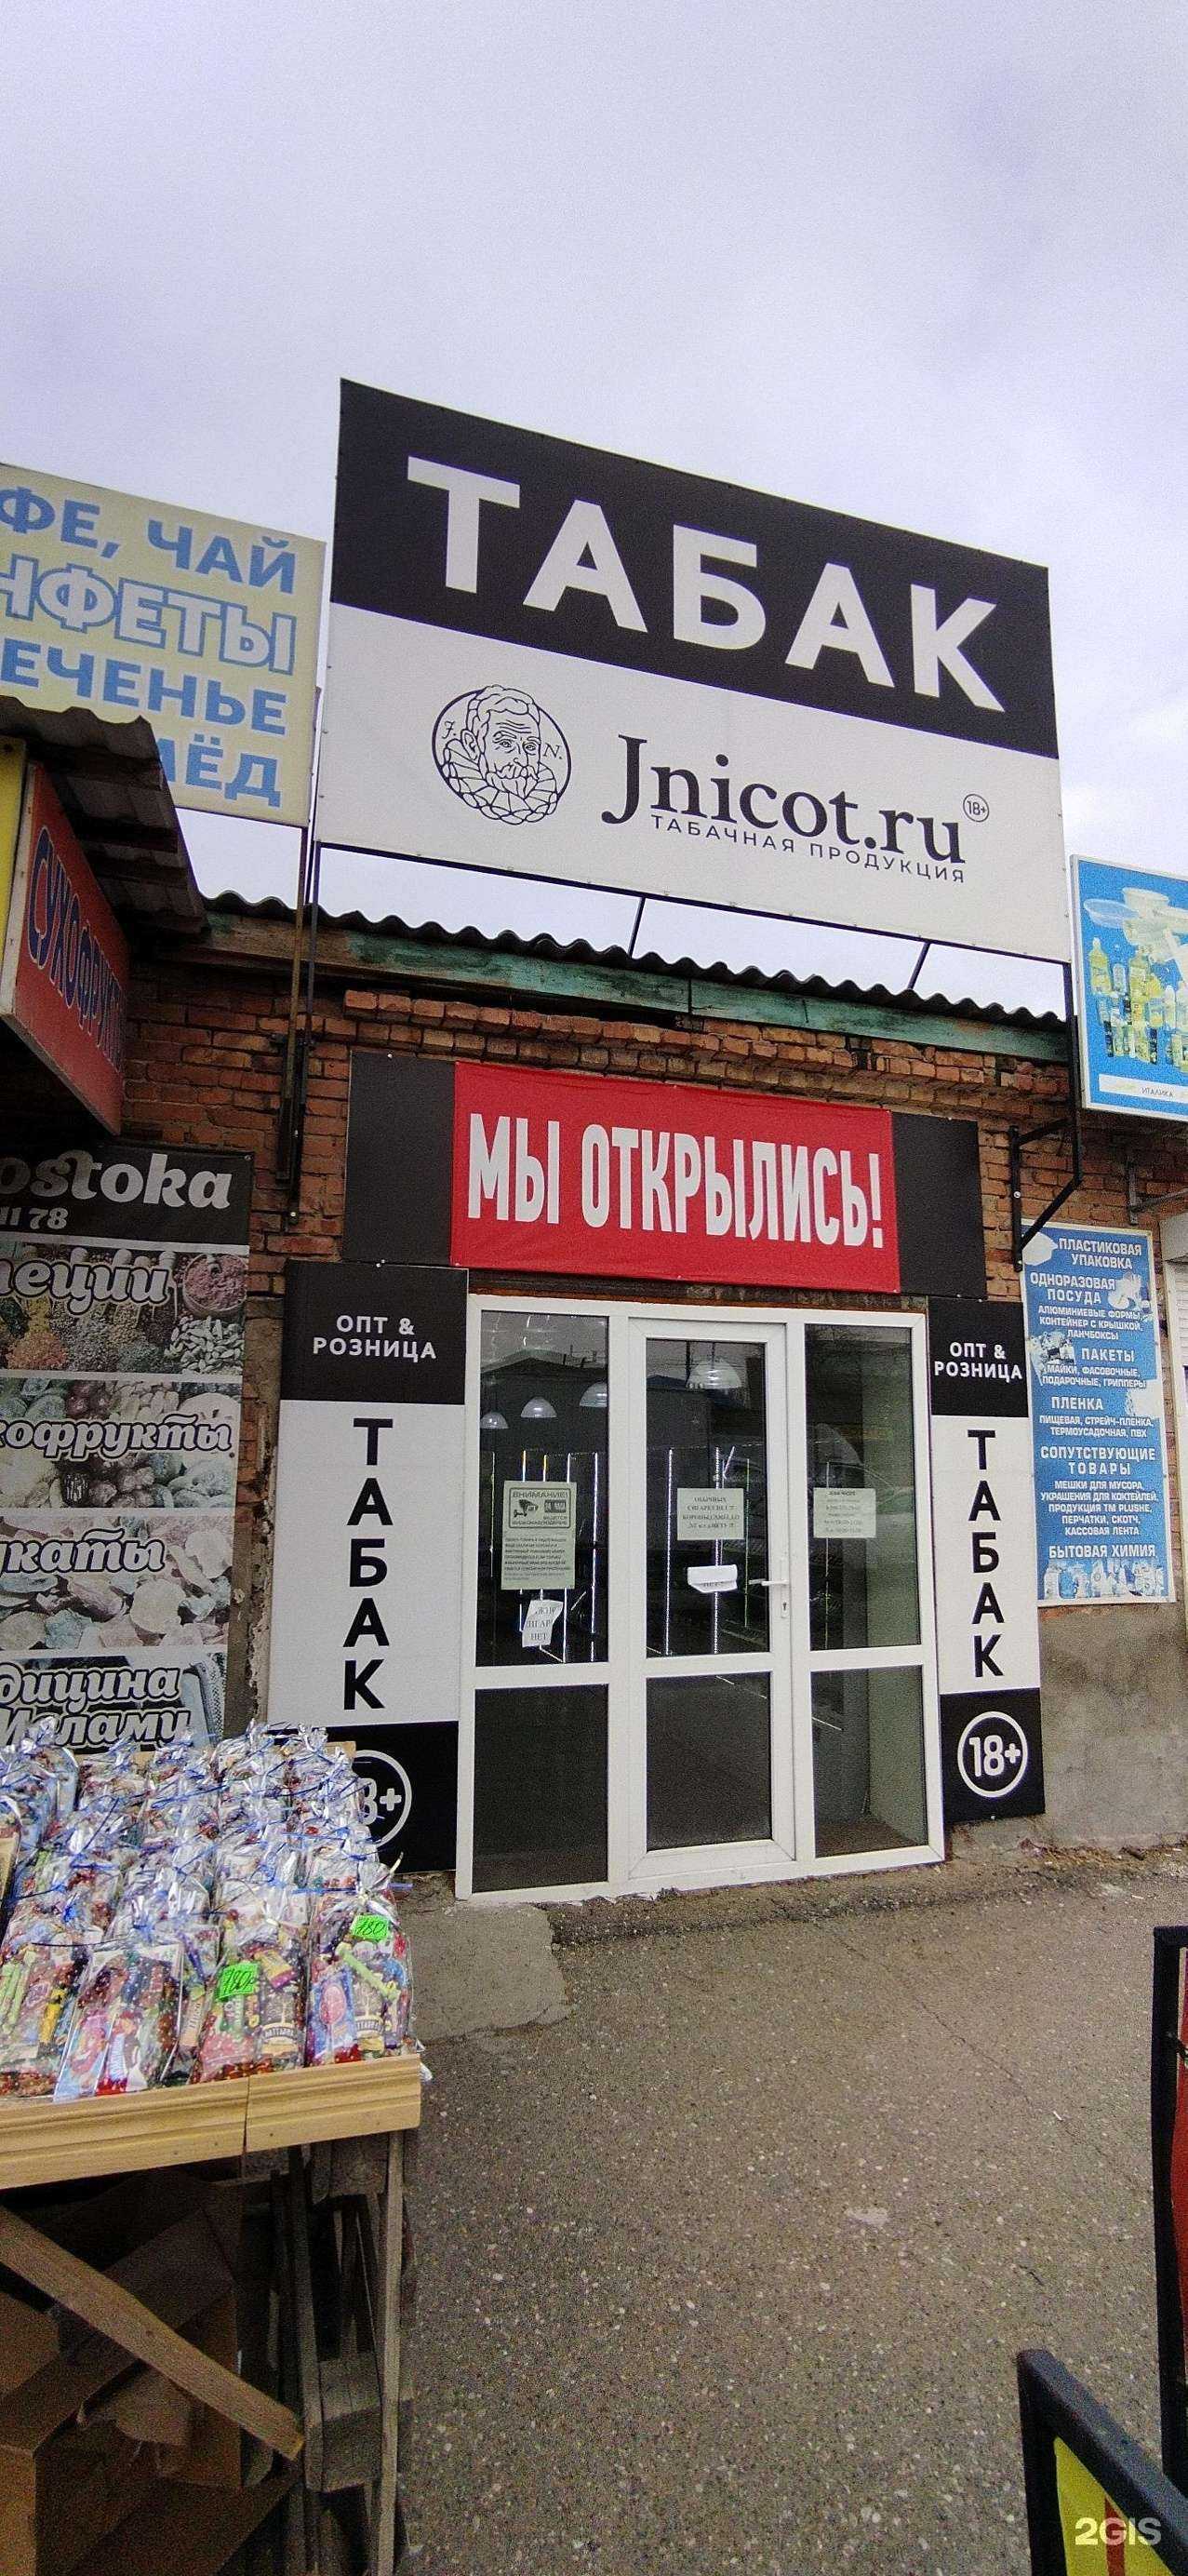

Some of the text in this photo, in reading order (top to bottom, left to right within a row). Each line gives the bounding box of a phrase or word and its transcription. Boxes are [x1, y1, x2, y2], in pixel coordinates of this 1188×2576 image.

[147, 519, 296, 594] ЧАЙ
[407, 456, 1005, 712] ТАБАК
[601, 733, 966, 864] Jnicot.ru
[651, 814, 965, 883] ТАБАЧНАЯ ПРОДУКЦИЯ
[468, 1113, 883, 1248] МЫ ОТКРЫЛИСЬ!
[29, 1207, 69, 1229] 78
[1058, 1238, 1142, 1255] ПЛАСТИКОВАЯ
[1071, 1254, 1133, 1269] УПАКОВКА
[1030, 1272, 1115, 1291] ОДНОРАЗОВАЯ
[1047, 1289, 1101, 1305] ПОСУДА
[336, 1315, 415, 1335] ОПТ &
[1039, 1316, 1088, 1328] КОНТЕЙНЕР
[1090, 1320, 1096, 1328] С
[1067, 1329, 1118, 1340] ЛАНЧБОКСЫ
[313, 1337, 436, 1363] РОЗНИЦА
[949, 1341, 1007, 1360] ОПТ &
[1081, 1348, 1135, 1362] ПАКЕТЫ
[934, 1361, 1022, 1383] РОЗНИЦА
[1051, 1396, 1103, 1411] ПЛЕНКА
[0, 1414, 233, 1458] офрукты
[1130, 1429, 1147, 1438] ПВХ
[1040, 1446, 1155, 1462] СОПУТСТВУЮЩИЕ
[1068, 1462, 1131, 1475] ТОВАРЫ
[1054, 1481, 1088, 1490] МЕШКИ
[1089, 1481, 1107, 1491] ДЛЯ
[1040, 1492, 1091, 1501] УКРАШЕНИЯ
[1092, 1492, 1110, 1502] ДЛЯ
[1048, 1504, 1101, 1513] ПРОДУКЦИЯ
[1065, 1527, 1140, 1536] КАССОВАЯ ЛЕНТА
[0, 1529, 165, 1576] каты
[967, 1429, 1005, 1677] ТАБАК
[1048, 1545, 1155, 1559] БЫТОВАЯ ХИМИЯ
[342, 1417, 394, 1711] ТАБАК
[968, 1734, 1021, 1778] 18+
